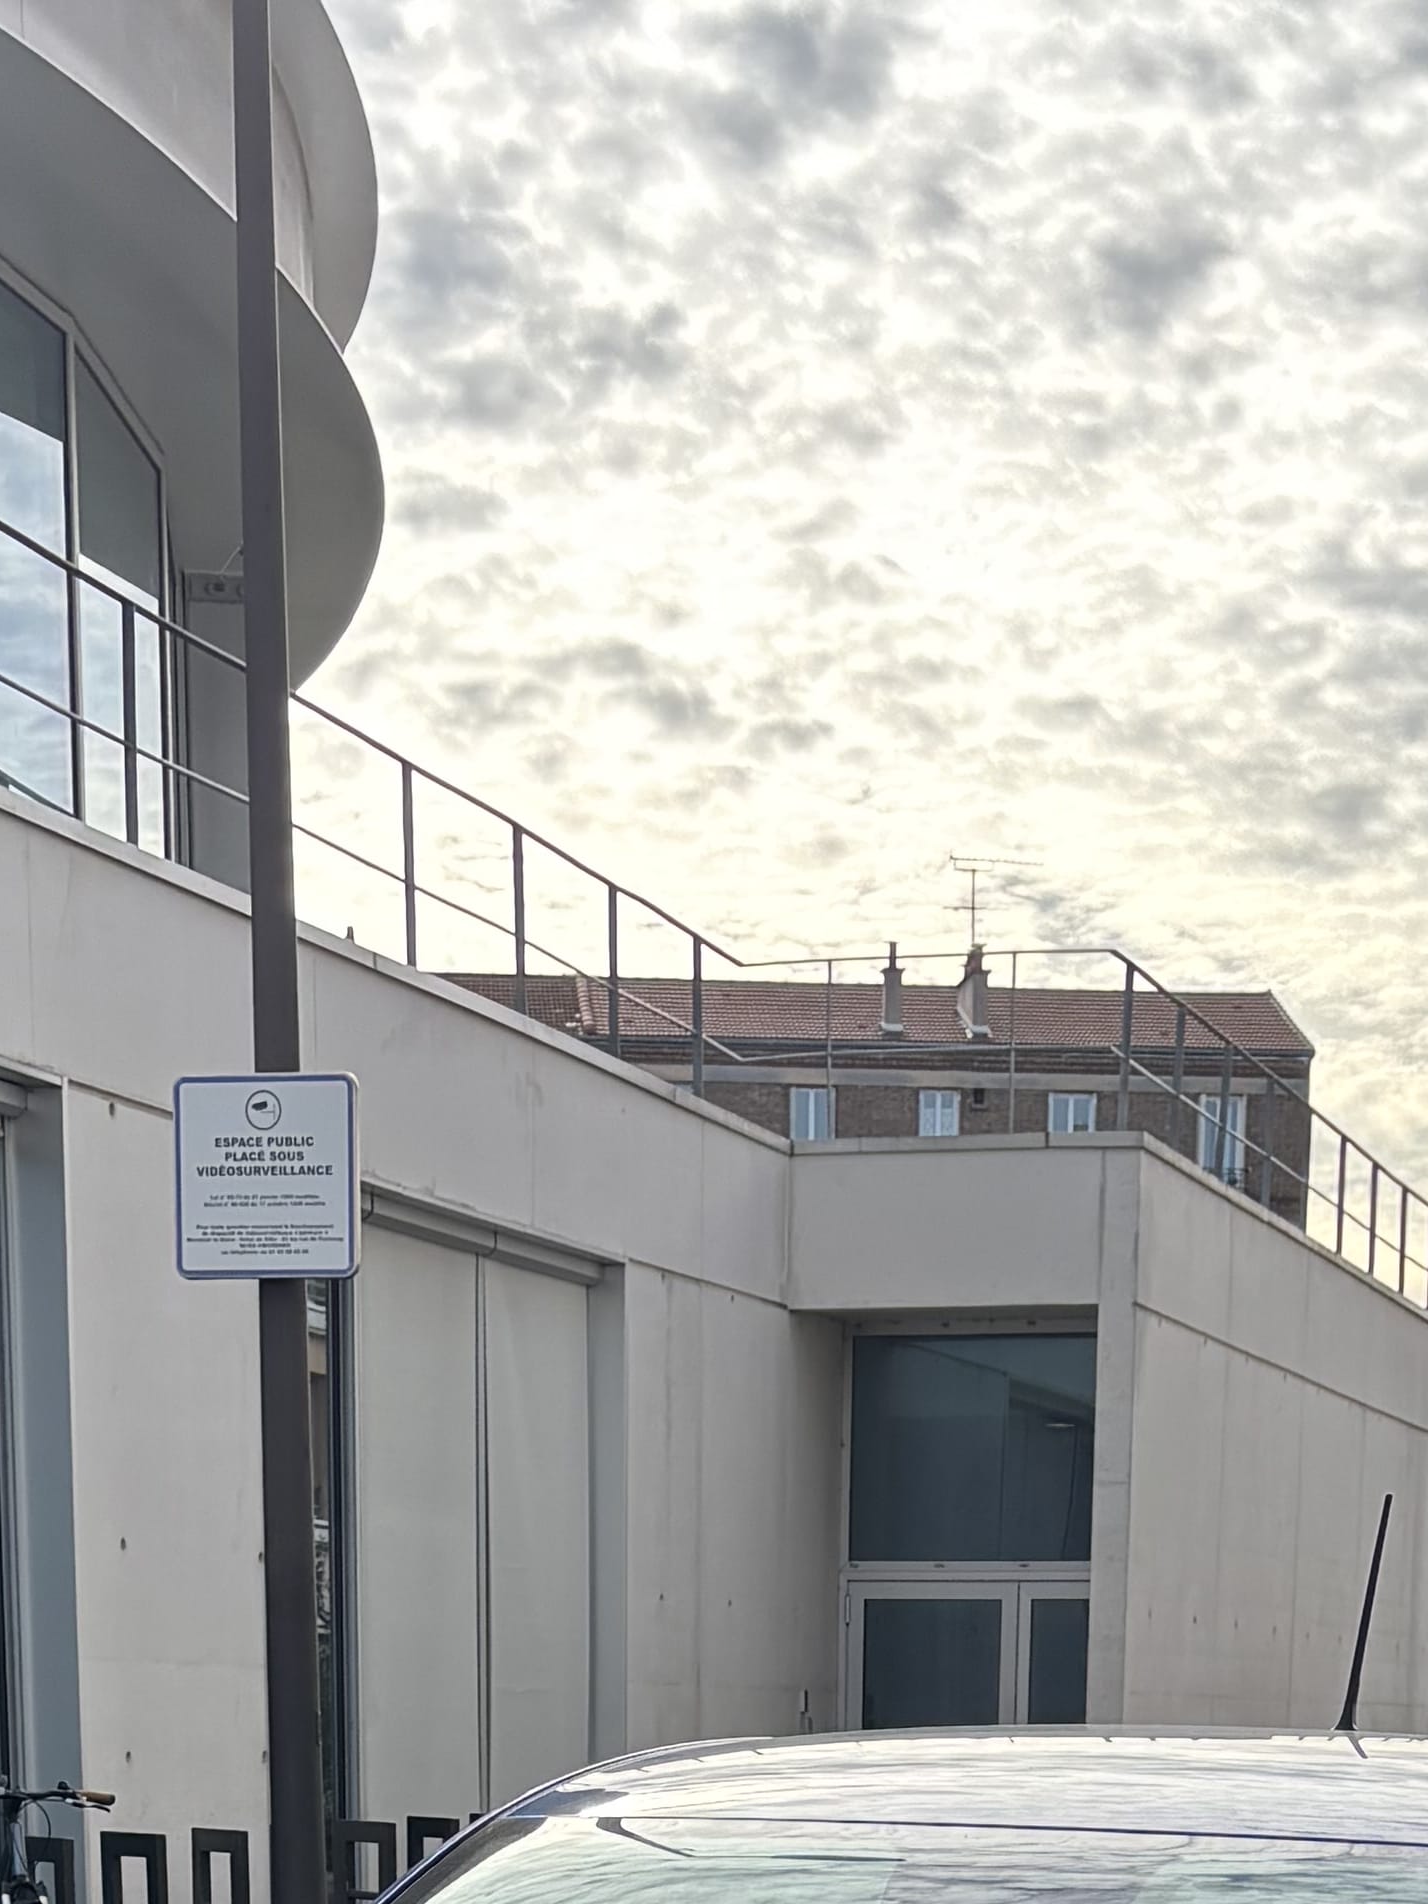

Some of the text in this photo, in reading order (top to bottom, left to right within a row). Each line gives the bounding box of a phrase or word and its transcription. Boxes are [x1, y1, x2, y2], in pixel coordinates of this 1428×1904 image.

[214, 1135, 314, 1148] ESPACE PUBLIC
[224, 1150, 305, 1162] PLACÉ SOUS
[196, 1164, 333, 1177] VIDÉOSURVEILLANCE
